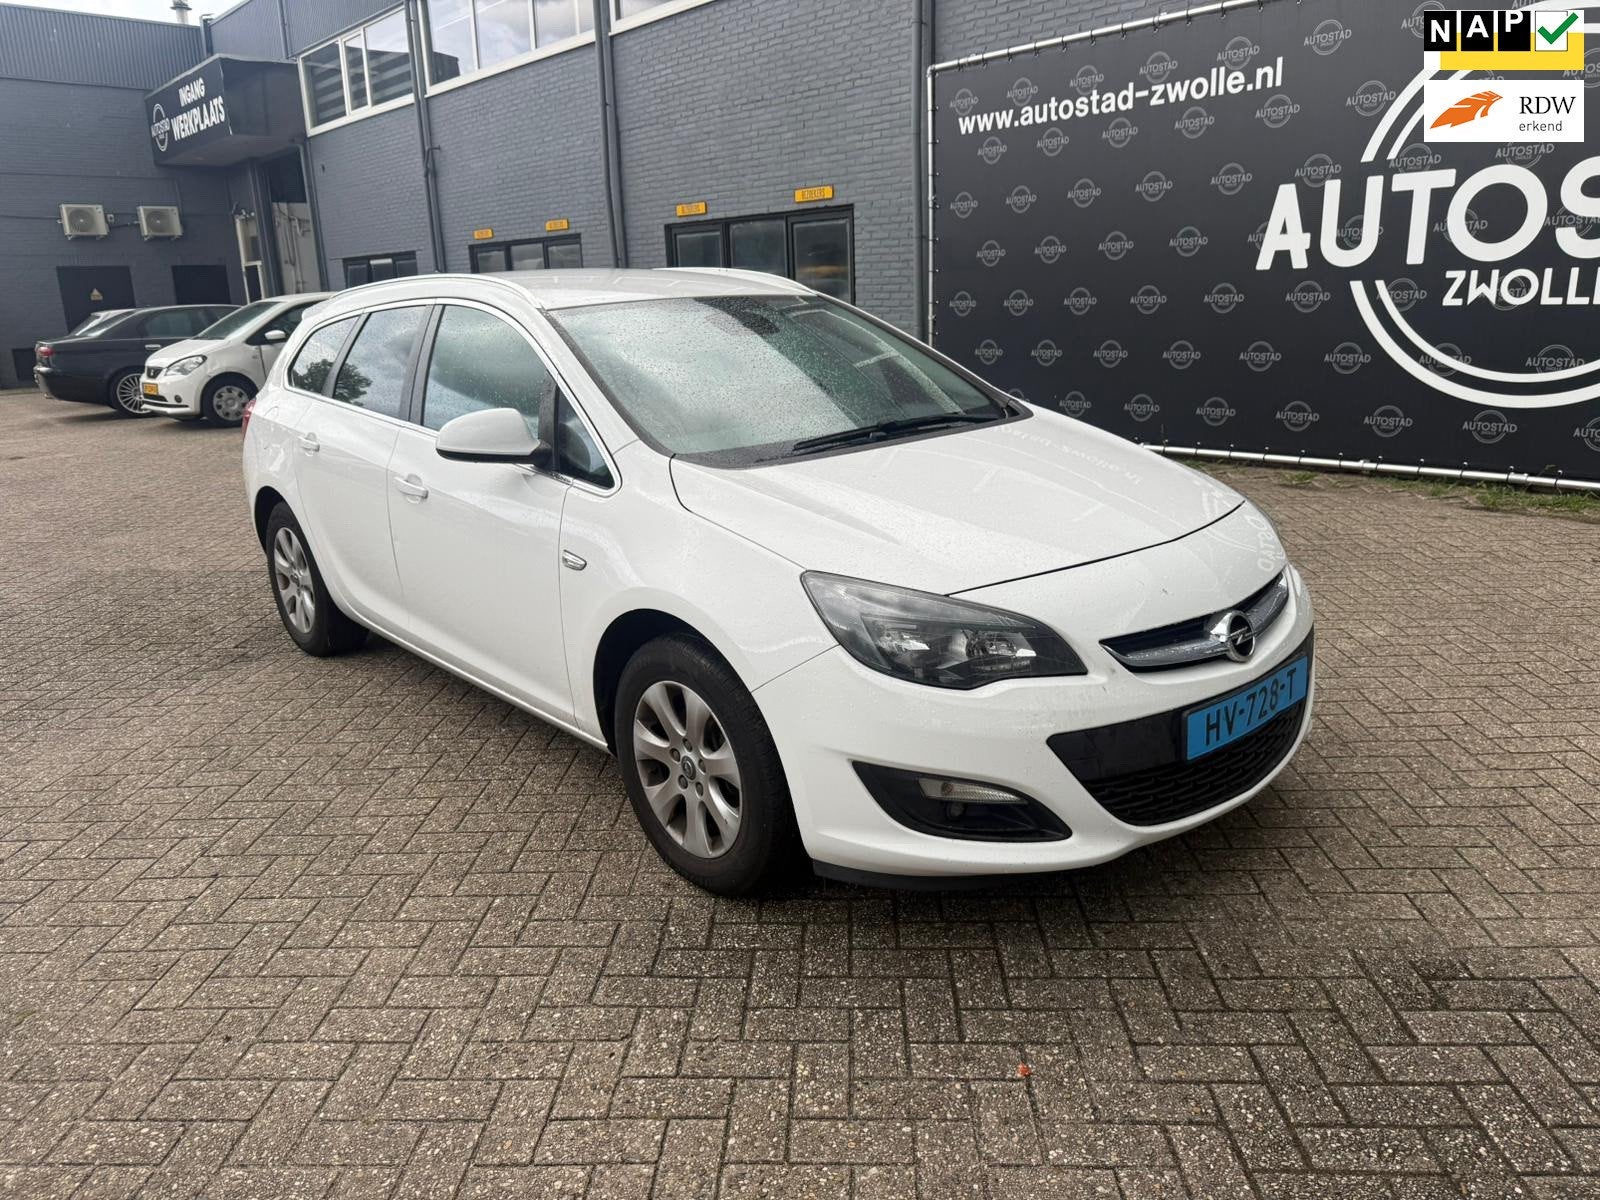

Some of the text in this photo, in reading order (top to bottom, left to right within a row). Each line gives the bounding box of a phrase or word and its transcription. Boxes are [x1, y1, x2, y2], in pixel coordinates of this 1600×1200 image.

[1303, 29, 1352, 48] AUTOSTAD
[1216, 45, 1260, 61] AUTOSTAD
[1138, 60, 1178, 75] AUTOSTAD
[178, 78, 205, 107] INGANG
[958, 57, 1284, 136] www.autostad-zwolle.nl
[1346, 90, 1397, 107] AUTOSTAD
[171, 95, 225, 141] WERKPLAATS
[1255, 103, 1300, 119] AUTOSTAD
[1174, 115, 1215, 131] AUTOSTAD
[1495, 143, 1555, 160] AUTOSTAD
[1389, 154, 1442, 169] AUTOSTAD
[1295, 165, 1342, 178] AUTOSTAD
[1210, 173, 1253, 187] AUTOSTAD
[1135, 181, 1173, 194] AUTOSTAD
[1169, 236, 1208, 248] AUTOSTAD
[1442, 267, 1600, 306] ZWOLL
[1130, 295, 1167, 306] AUTOSTAD
[1203, 293, 1245, 304] AUTOSTAD
[1285, 291, 1331, 303] AUTOSTAD
[1162, 350, 1201, 361] AUTOSTAD
[1239, 351, 1282, 362] AUTOSTAD
[1324, 352, 1372, 364] AUTOSTAD
[1196, 406, 1236, 418] AUTOSTAD
[1275, 411, 1320, 423] AUTOSTAD
[1363, 415, 1414, 429] AUTOSTAD
[1462, 420, 1518, 434] AUTOSTAD
[1205, 667, 1297, 746] HV-728-T
